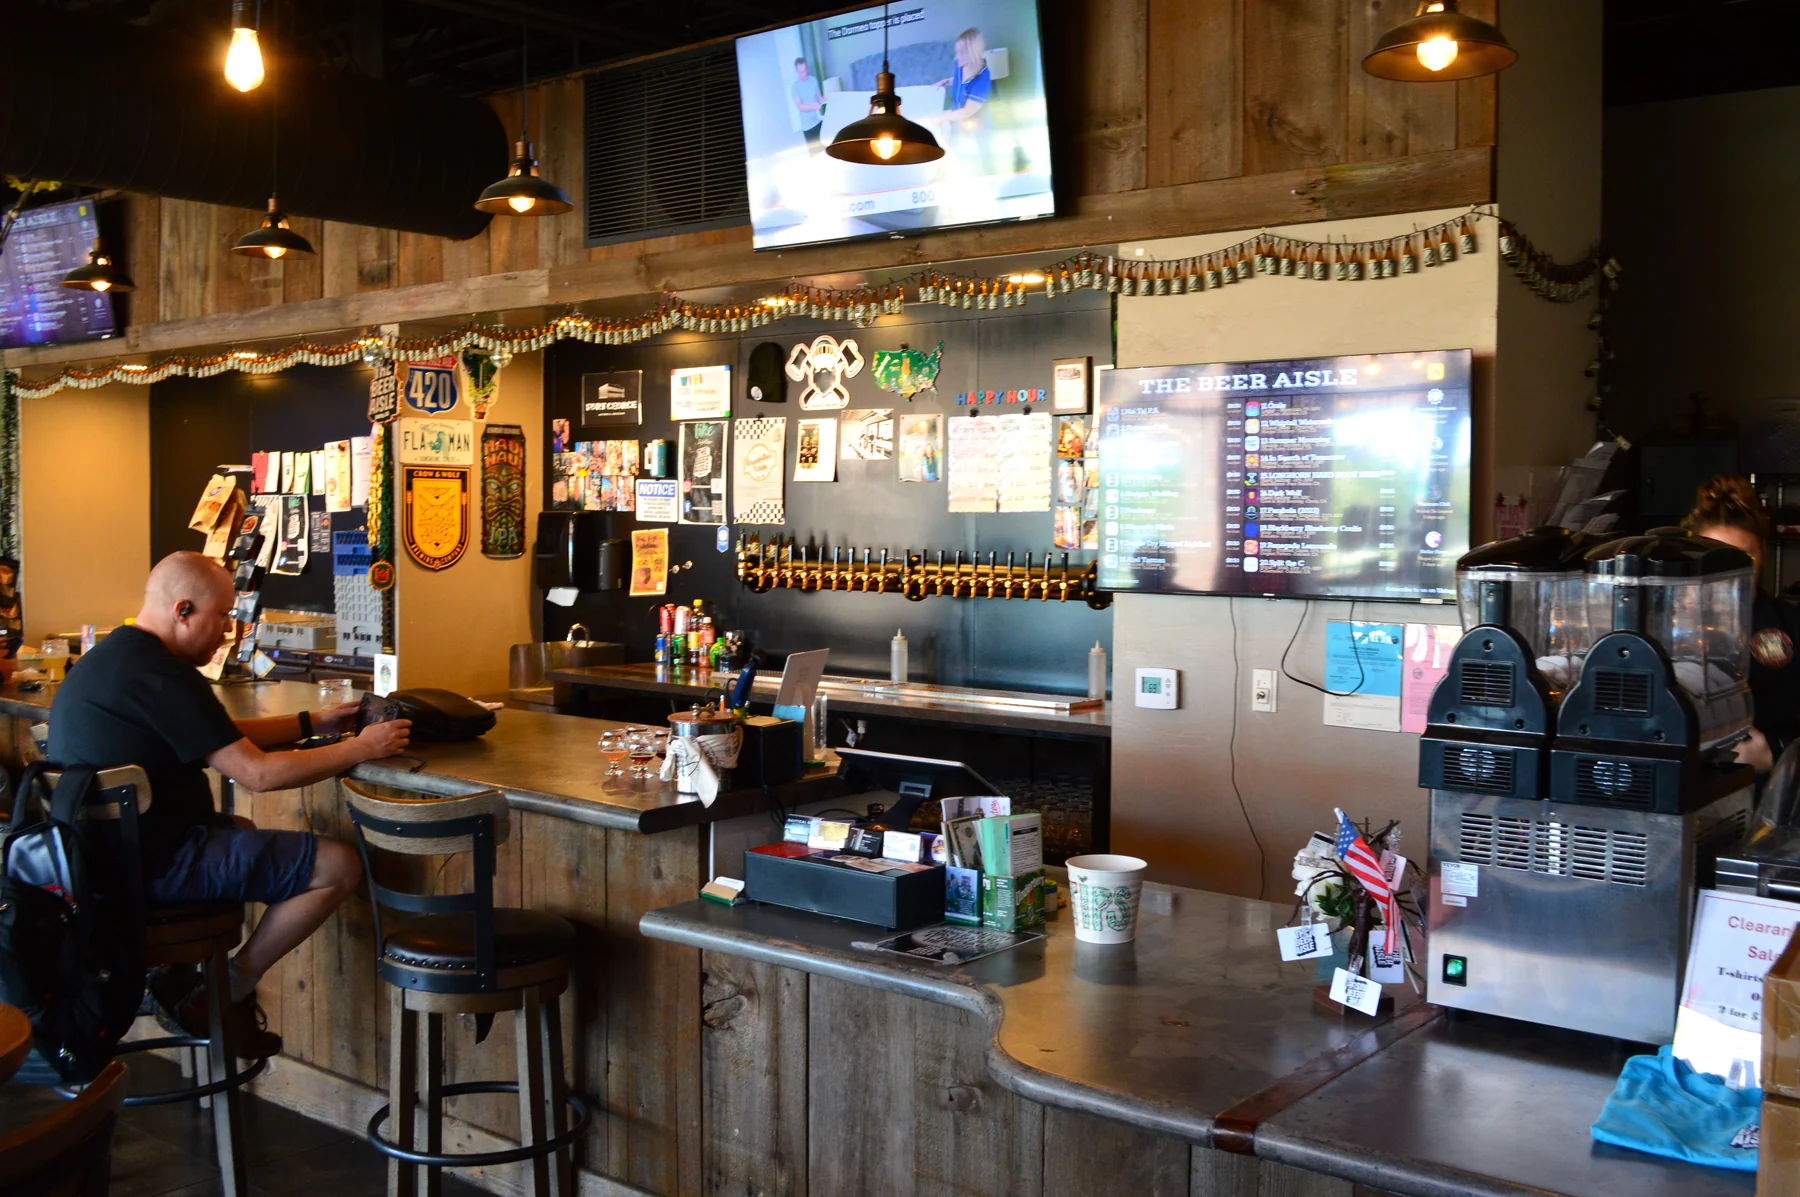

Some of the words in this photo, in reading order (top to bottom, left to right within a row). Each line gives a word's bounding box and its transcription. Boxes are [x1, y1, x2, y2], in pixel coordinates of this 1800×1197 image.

[870, 18, 892, 30] toppr
[900, 9, 924, 24] placed
[371, 375, 396, 398] BEER
[409, 371, 451, 409] 420
[1139, 376, 1191, 395] THE
[1196, 373, 1268, 392] BEER
[1271, 368, 1358, 389] AISLE
[369, 392, 396, 415] AISLE
[957, 390, 1004, 406] HAPPY
[1007, 388, 1047, 404] HOUR
[403, 430, 426, 451] FLA
[448, 432, 470, 453] MAN
[639, 483, 676, 496] NOTICE
[488, 526, 518, 546] IPA
[1069, 881, 1131, 932] TIPS
[1728, 915, 1792, 937] Clearan
[1730, 1007, 1748, 1019] for
[1729, 1135, 1760, 1148] AIS
